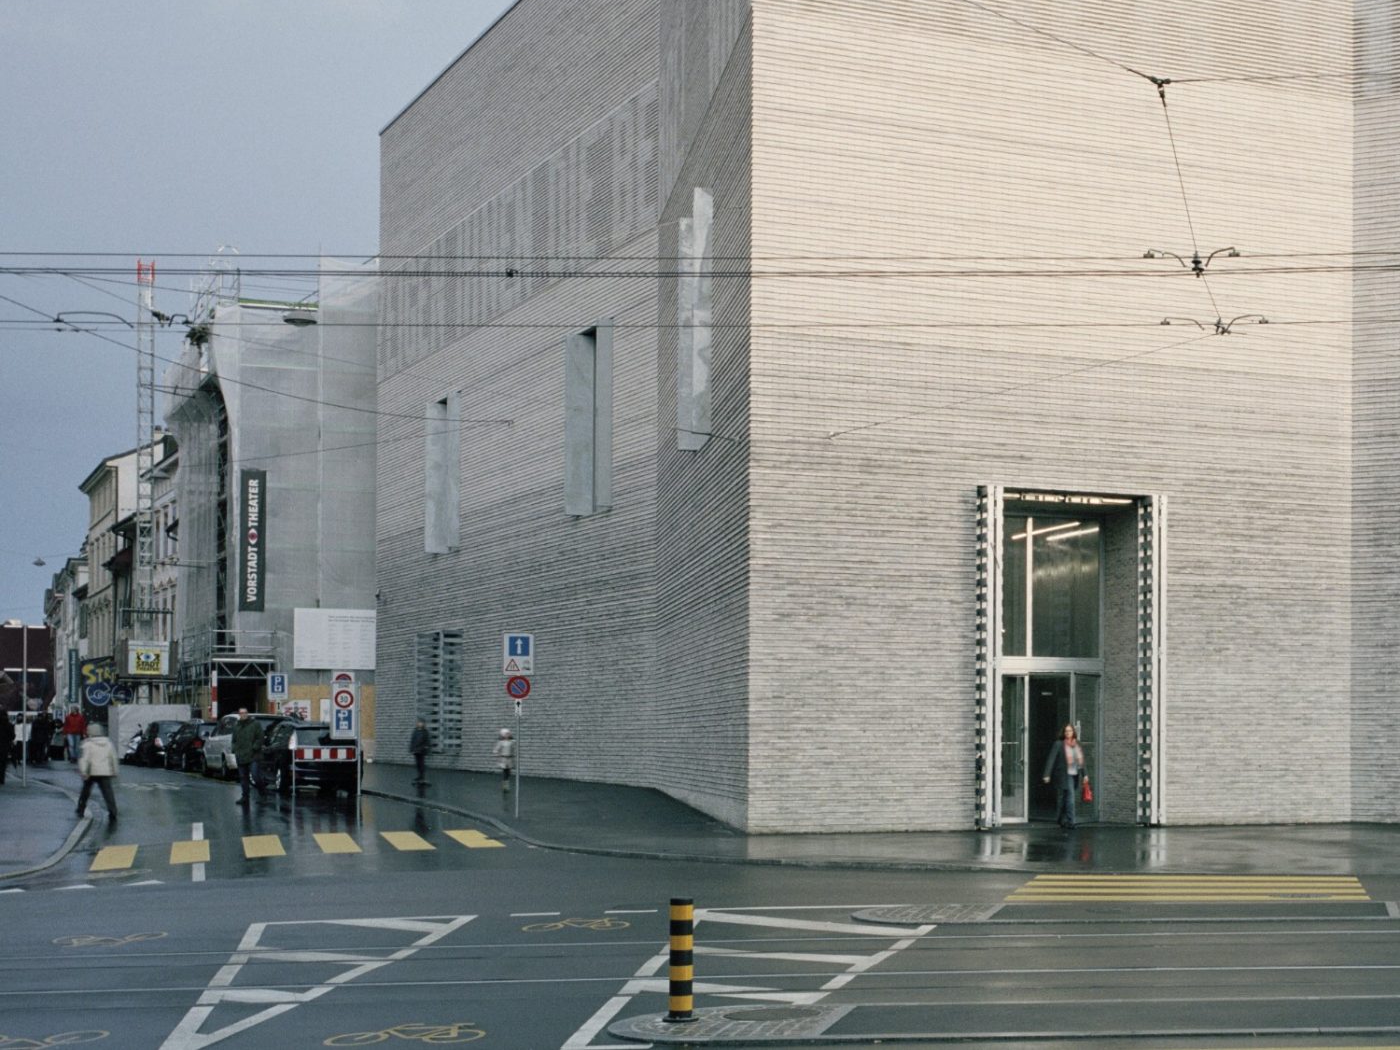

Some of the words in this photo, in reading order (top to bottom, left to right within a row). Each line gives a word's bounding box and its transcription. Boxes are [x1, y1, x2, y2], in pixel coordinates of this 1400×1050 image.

[248, 478, 259, 527] THEATER
[246, 546, 258, 602] VORSTADT
[339, 695, 349, 704] 30
